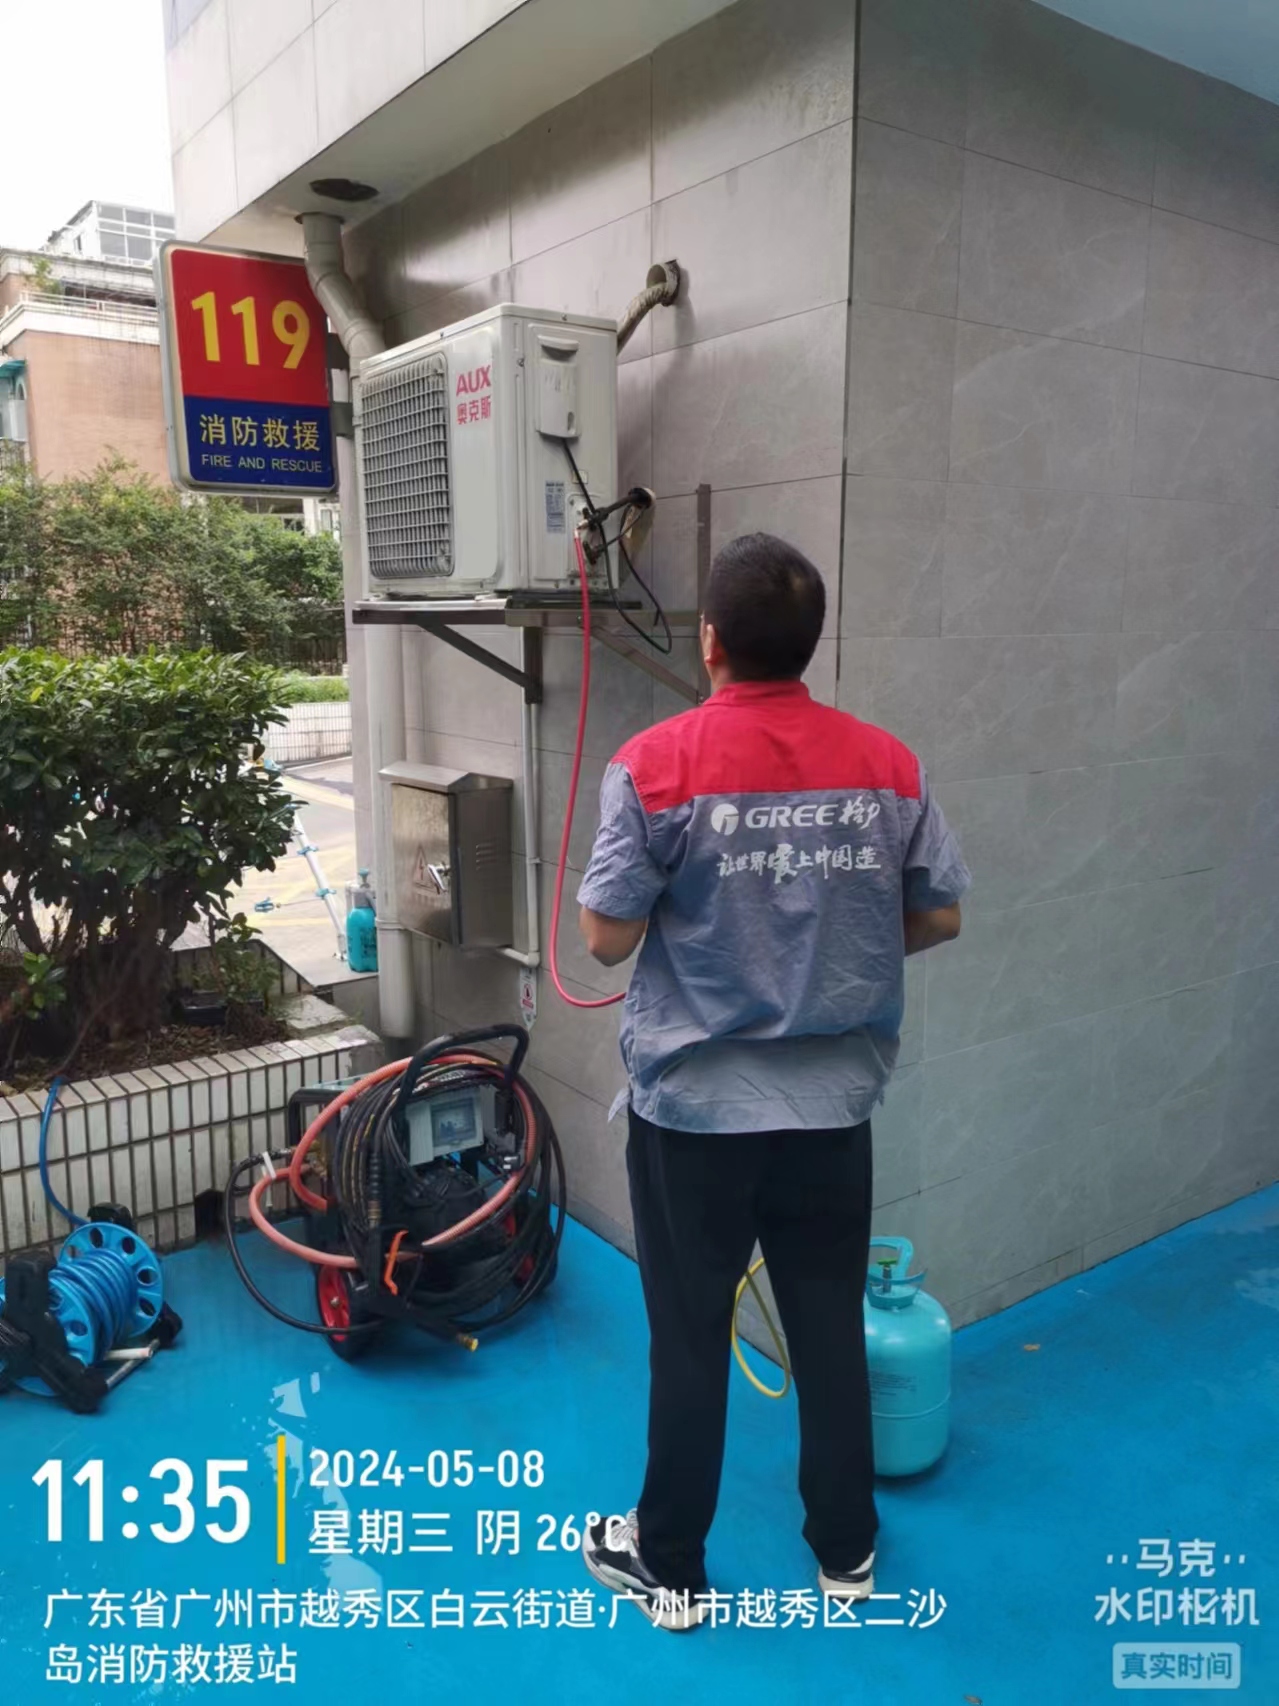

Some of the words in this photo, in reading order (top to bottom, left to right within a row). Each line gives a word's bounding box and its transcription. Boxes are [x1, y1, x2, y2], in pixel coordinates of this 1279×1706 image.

[191, 291, 310, 370] 119
[456, 364, 491, 397] AUX
[457, 395, 491, 425] 奥克斯
[200, 414, 320, 452] 消防救援
[201, 454, 232, 468] FIRE
[238, 456, 265, 470] AND
[272, 458, 322, 473] RESCUE
[745, 804, 839, 828] GREE
[717, 843, 881, 885] 让世界爱上中国造
